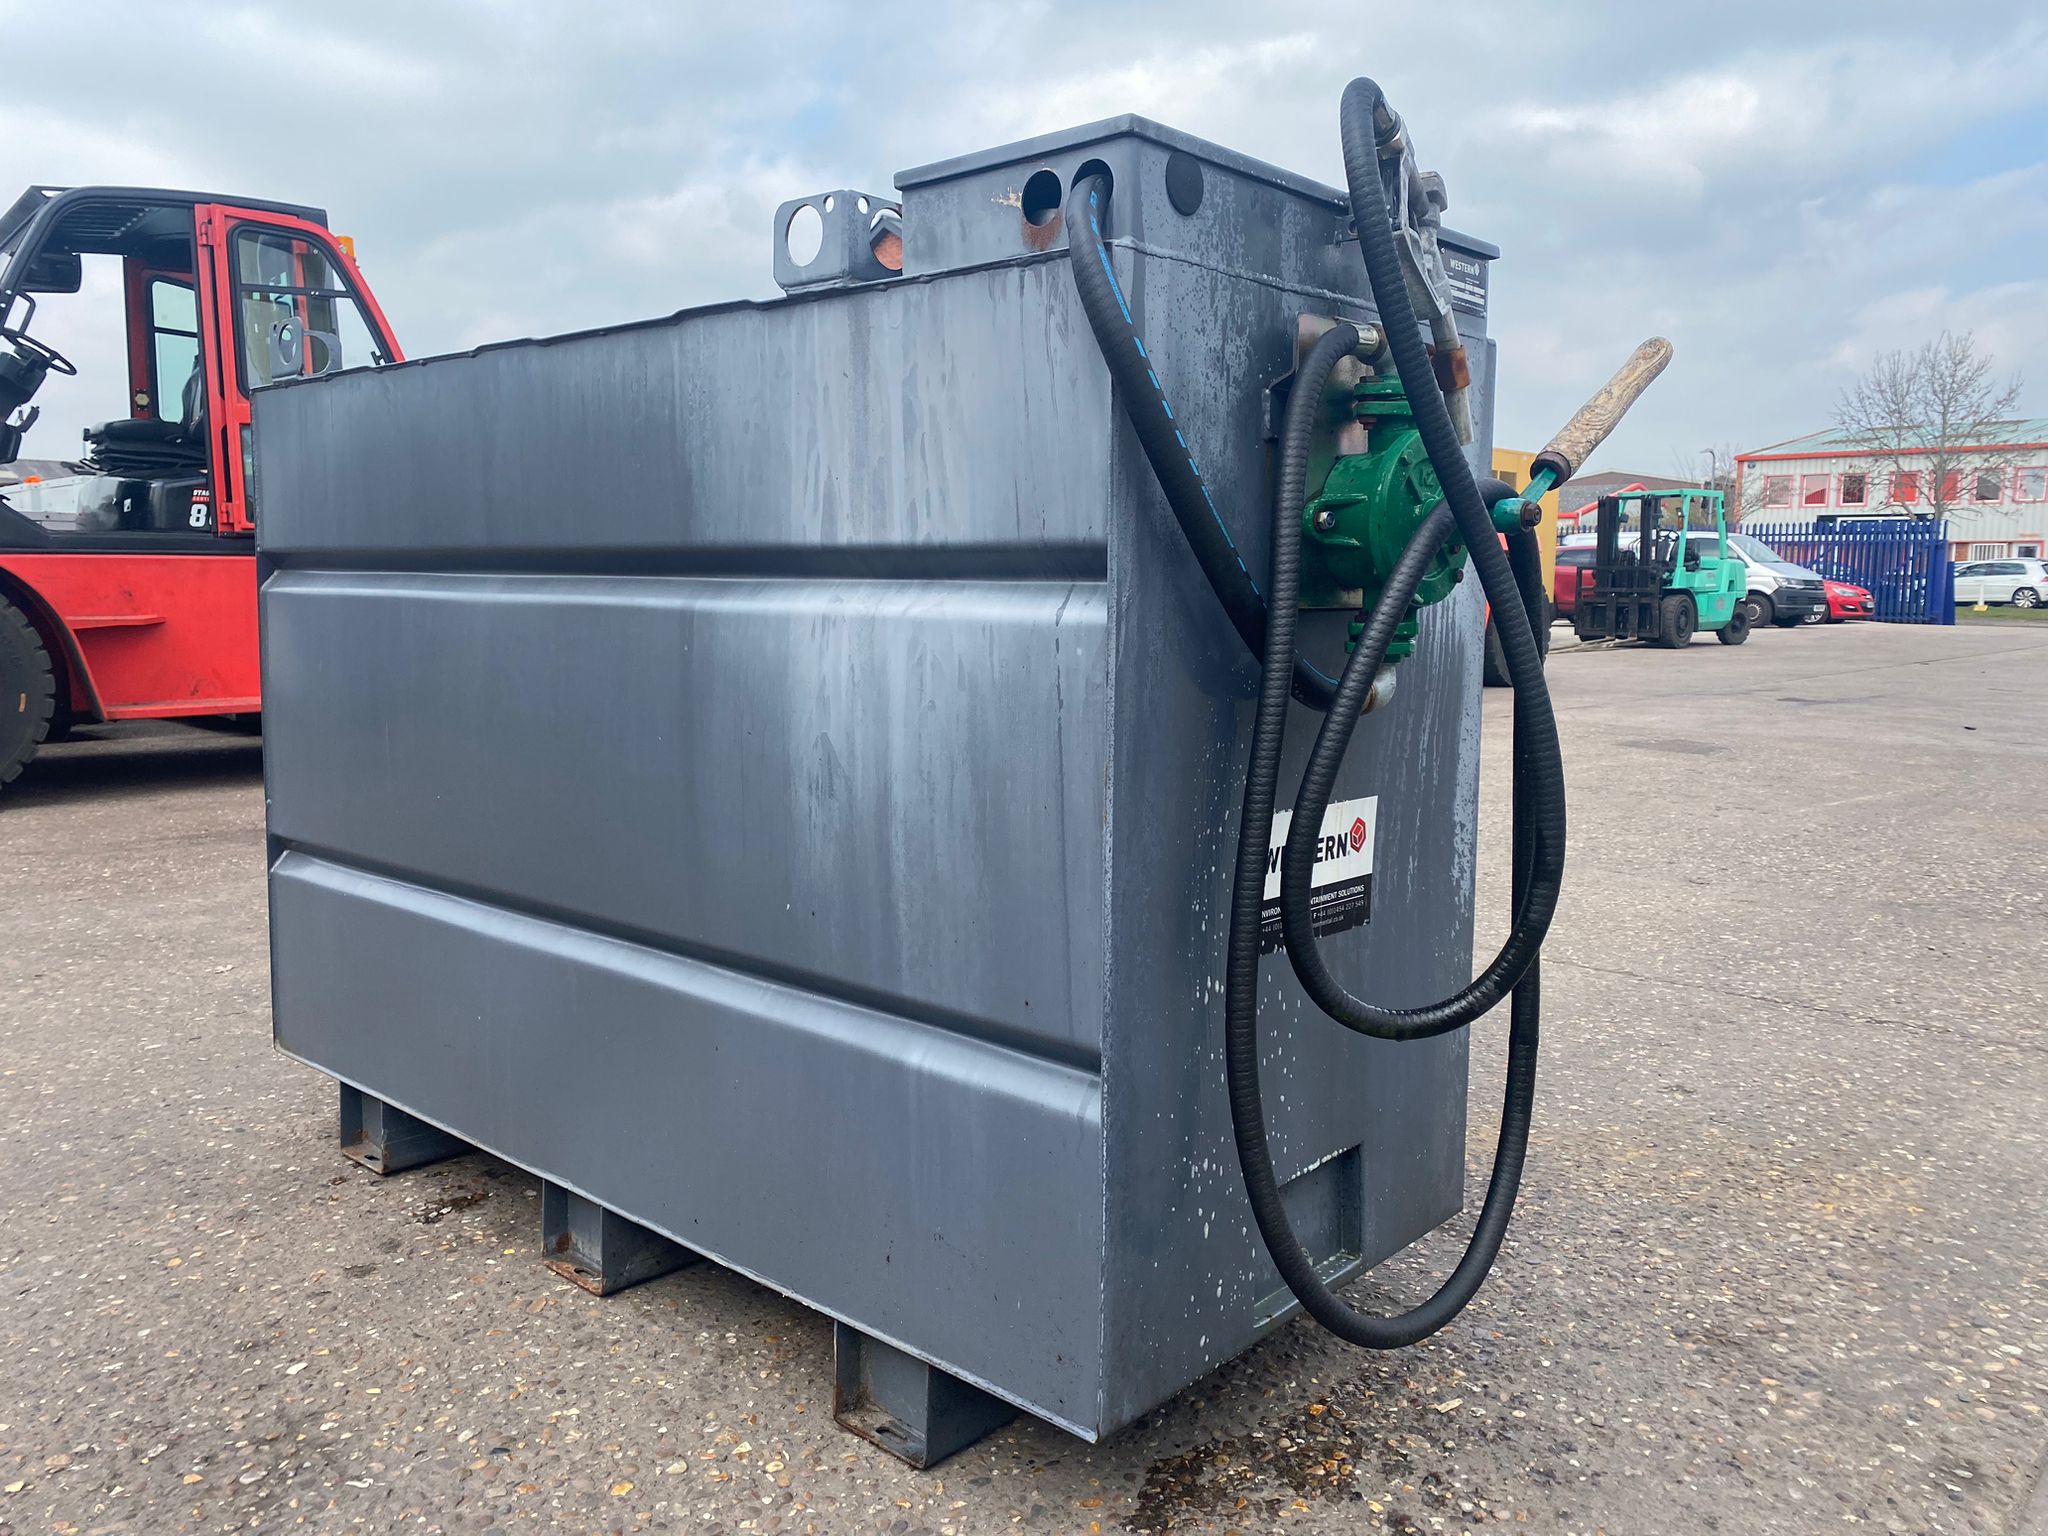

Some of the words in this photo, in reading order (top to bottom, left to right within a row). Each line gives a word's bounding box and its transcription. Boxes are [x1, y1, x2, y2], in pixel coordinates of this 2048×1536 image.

[1450, 258, 1475, 275] WESTERN
[1263, 833, 1347, 874] WERN
[1337, 884, 1365, 898] SOLUTIONS
